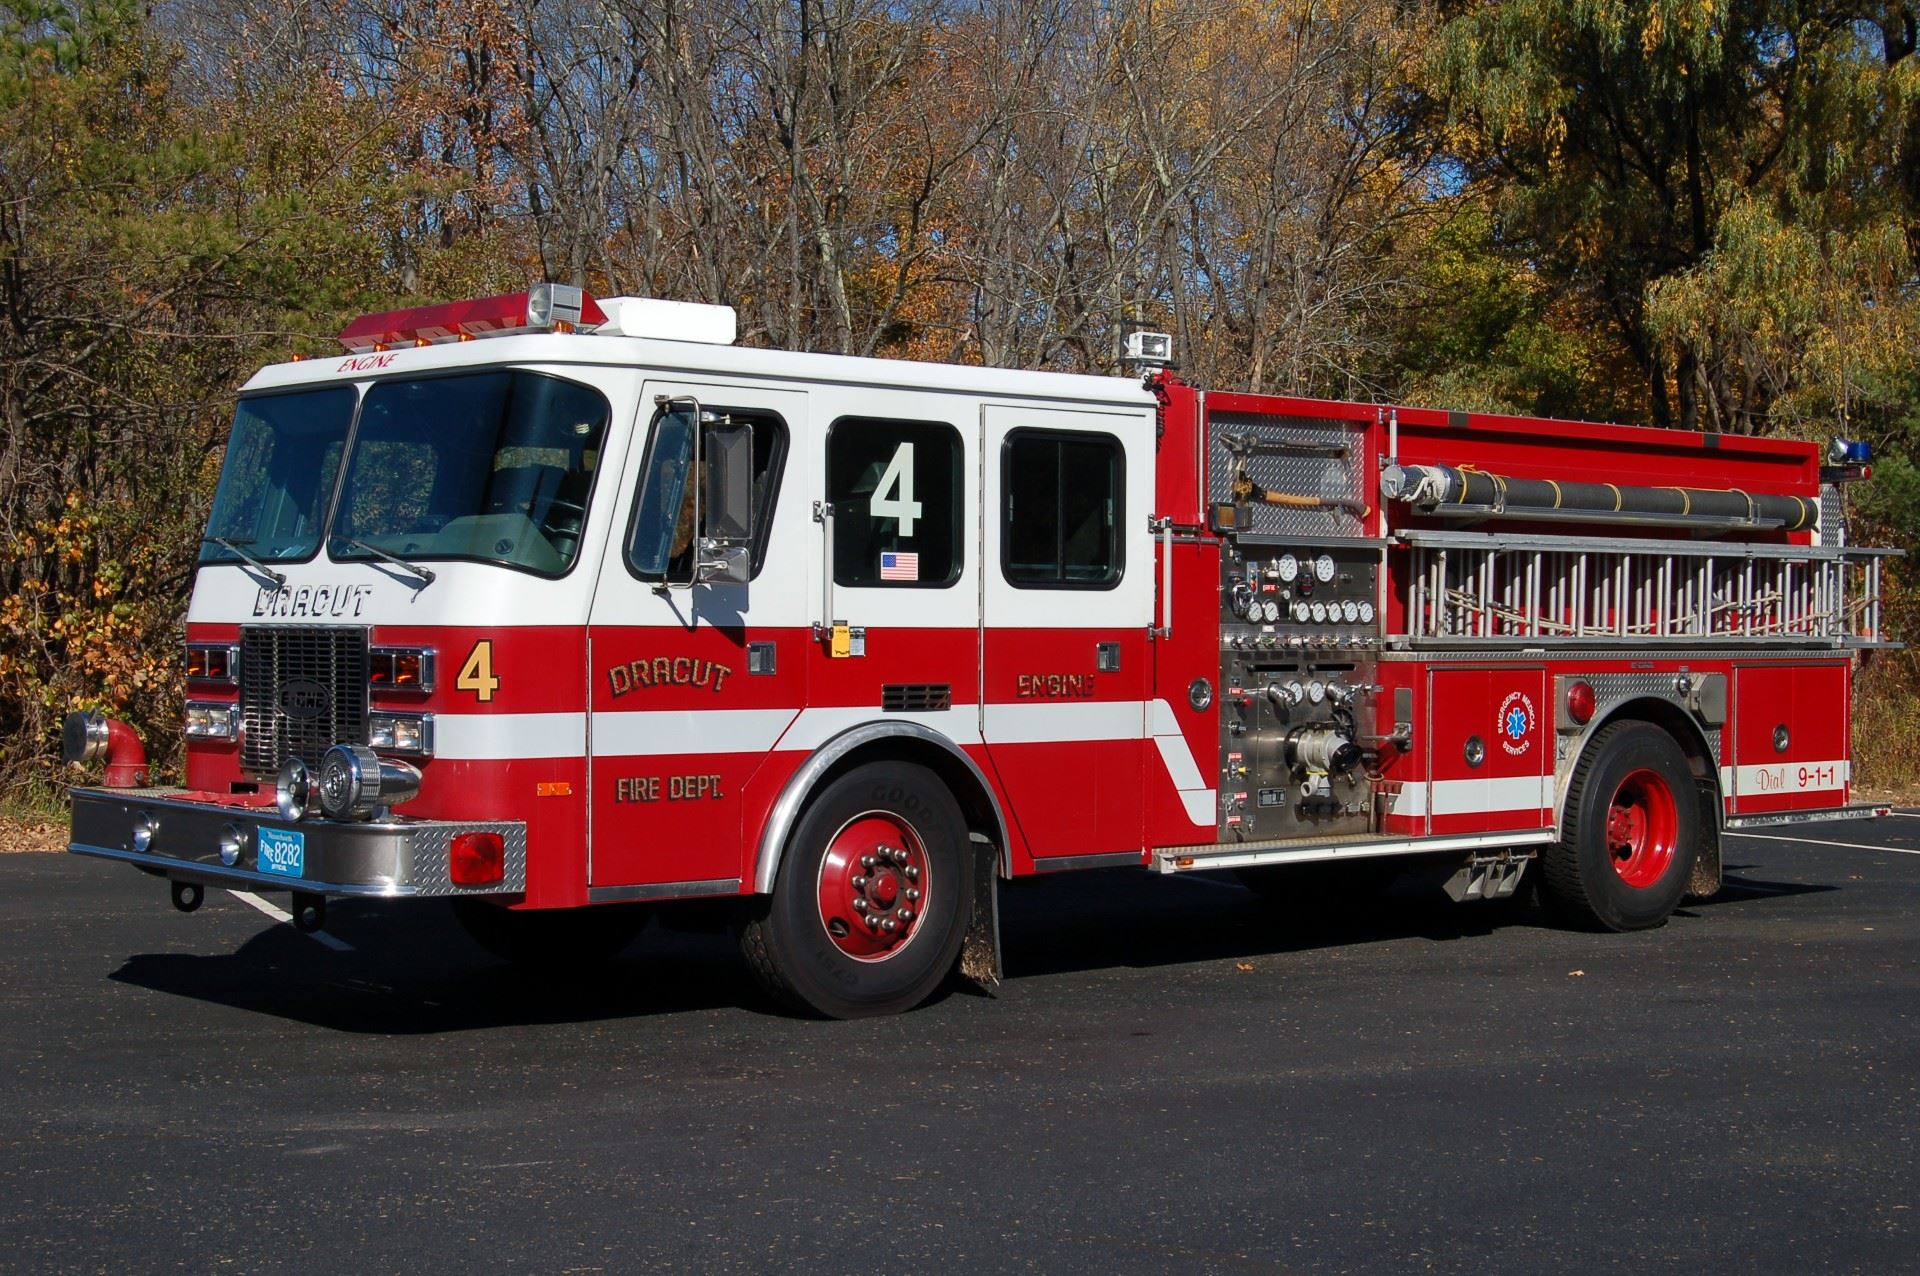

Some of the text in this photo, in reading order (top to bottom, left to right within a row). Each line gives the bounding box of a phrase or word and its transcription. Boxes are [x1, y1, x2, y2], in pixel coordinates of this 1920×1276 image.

[337, 353, 399, 372] ENGINE
[870, 442, 922, 537] 4
[253, 584, 374, 616] DRACUT
[456, 639, 501, 702] 4
[608, 657, 732, 698] DRACUT
[1017, 674, 1094, 697] ENGINE
[1497, 691, 1535, 734] EMERGENCY MEDICAL
[1502, 740, 1530, 756] SERVICES
[617, 774, 724, 802] FIRE DEPT.
[1755, 765, 1834, 791] Dial 9-1-1
[274, 841, 300, 867] 8282
